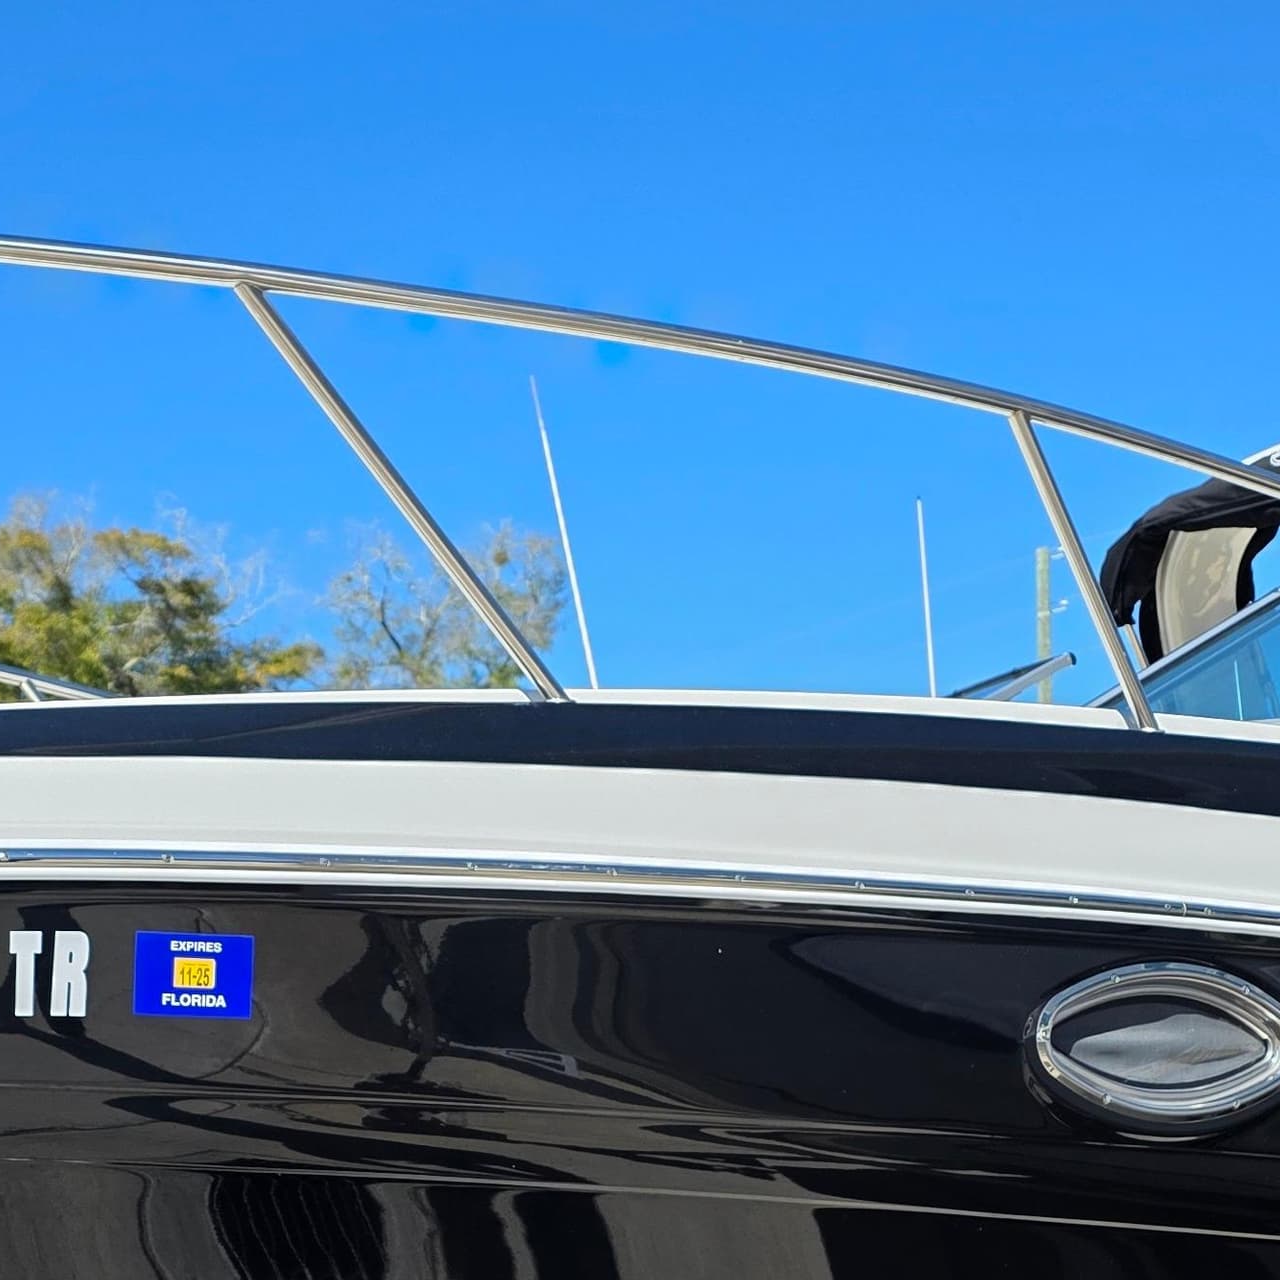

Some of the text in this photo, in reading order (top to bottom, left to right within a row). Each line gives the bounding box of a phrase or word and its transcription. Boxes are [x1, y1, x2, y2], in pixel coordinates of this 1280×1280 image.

[170, 940, 223, 953] EXPIRES
[180, 967, 210, 987] 11-25
[161, 993, 227, 1008] FLORIDA
